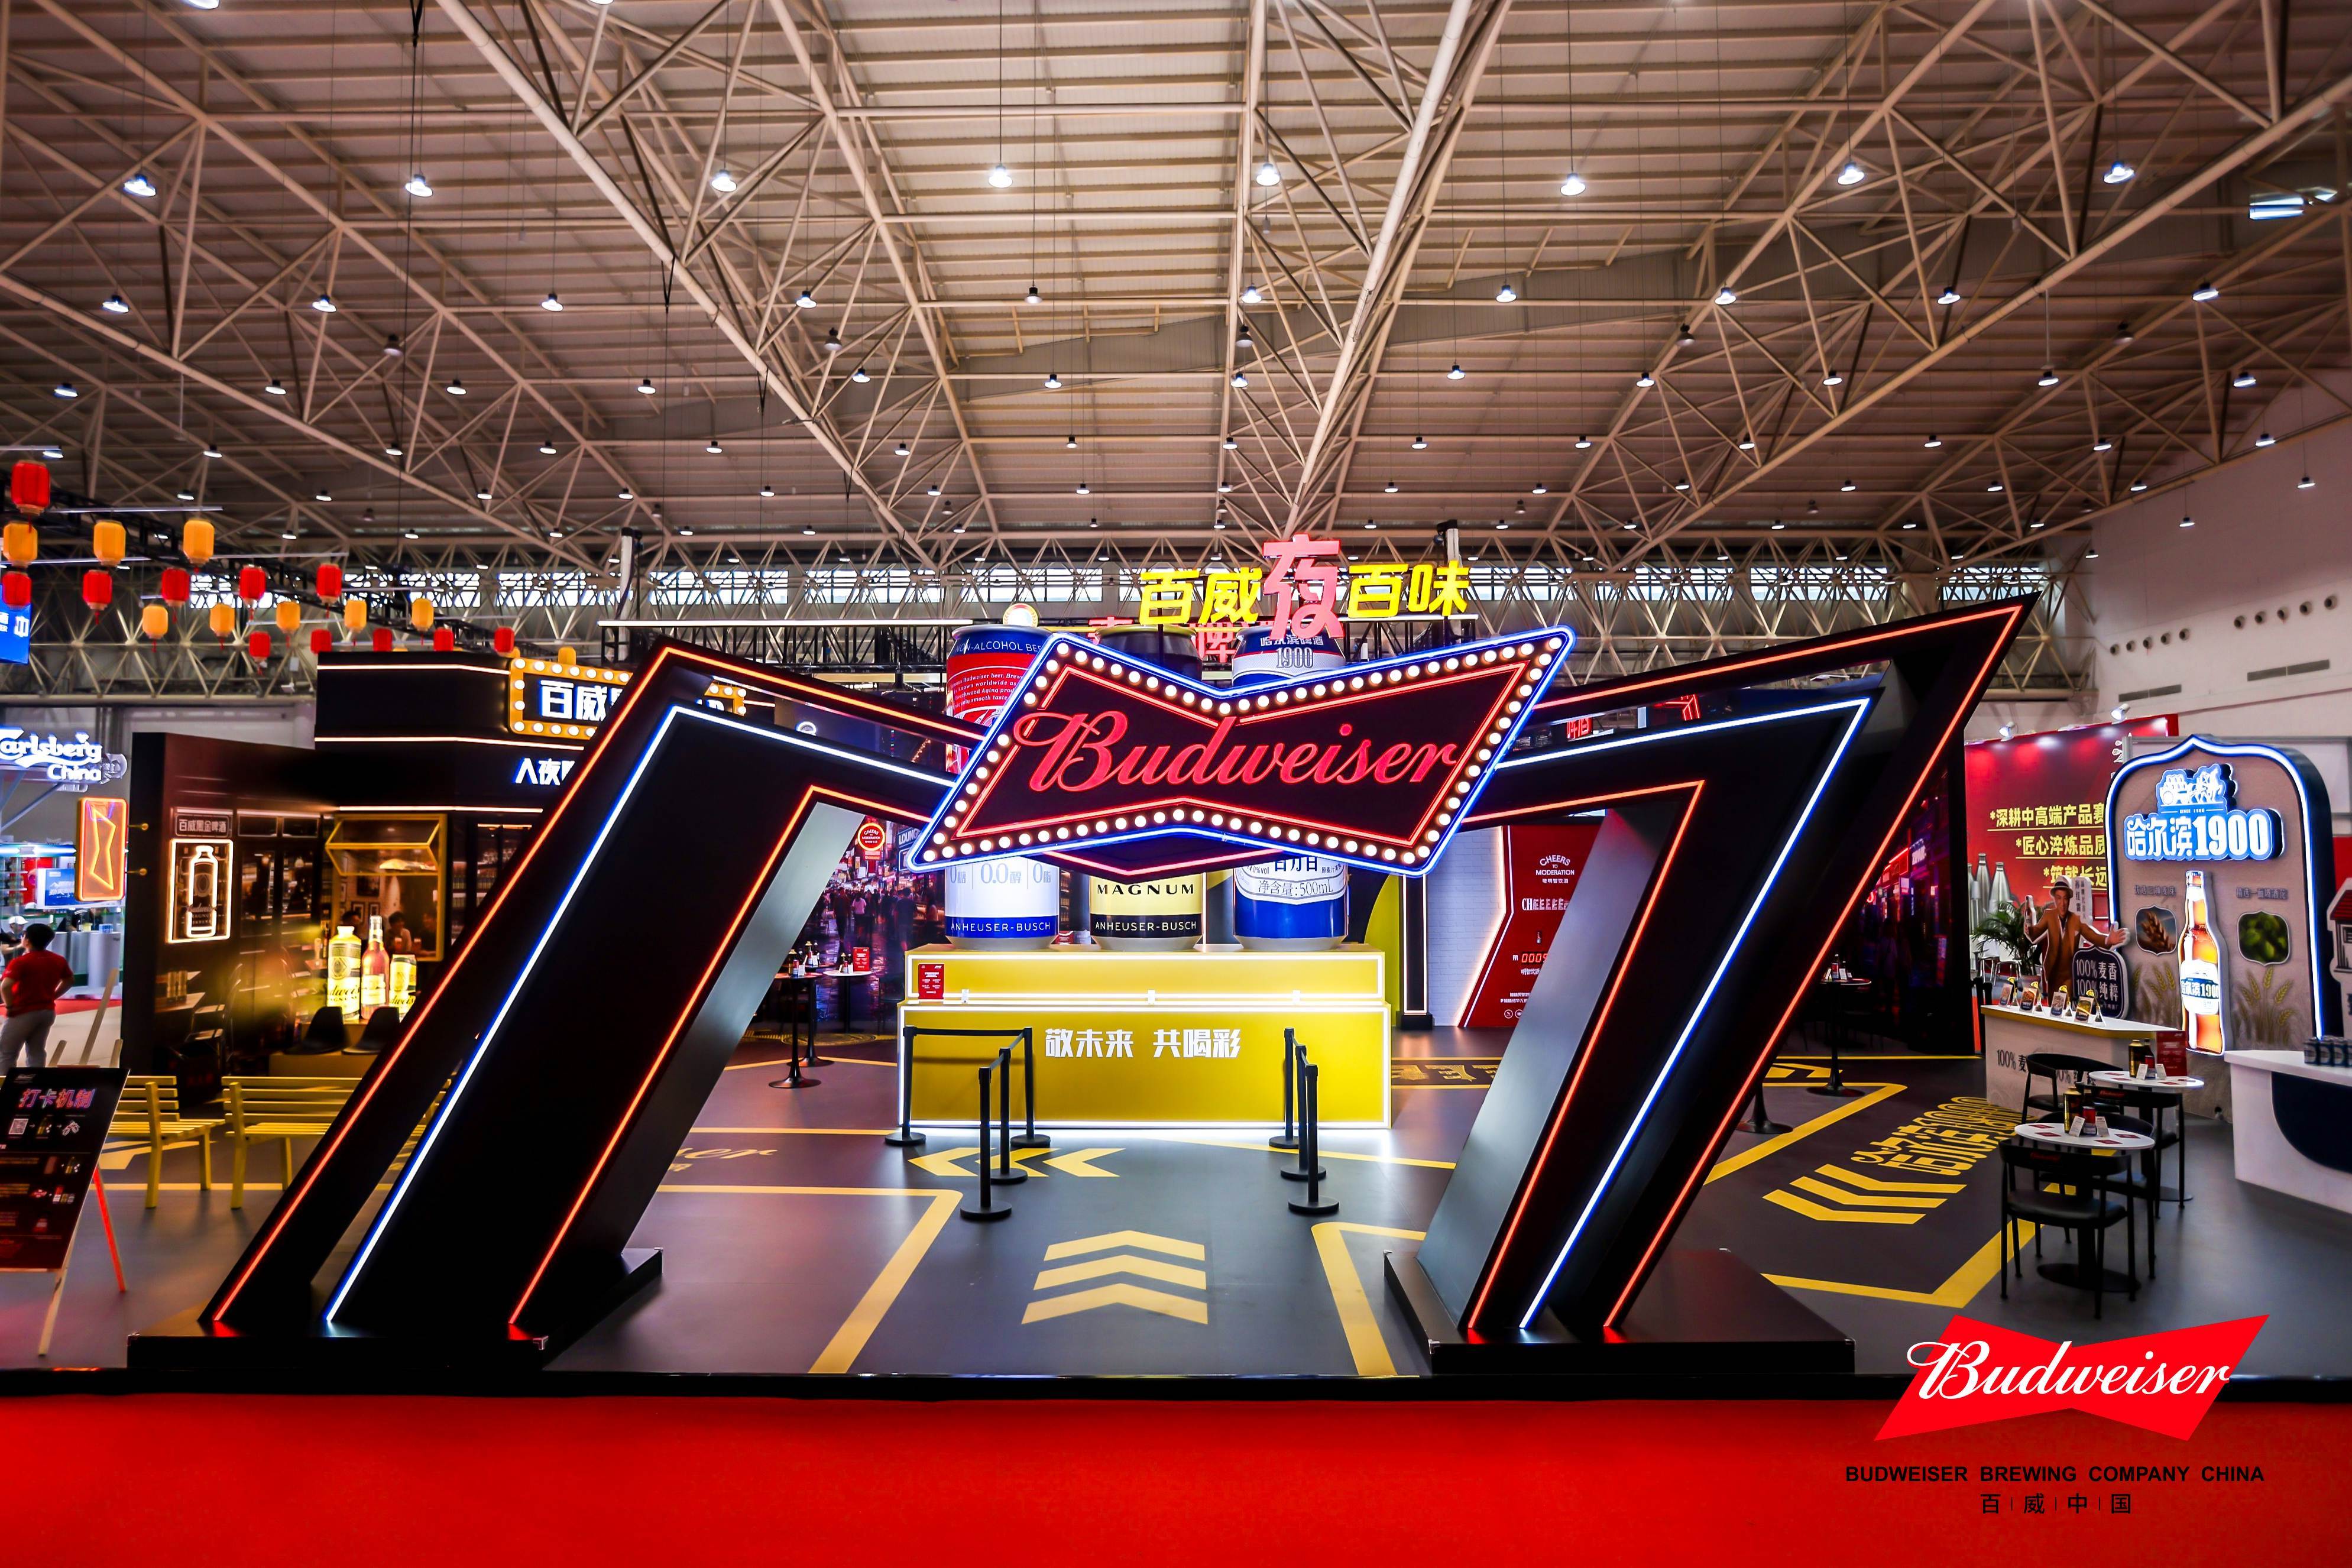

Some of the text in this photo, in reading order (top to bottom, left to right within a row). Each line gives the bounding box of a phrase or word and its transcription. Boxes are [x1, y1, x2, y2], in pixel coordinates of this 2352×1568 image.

[1026, 643, 1042, 652] BEE
[1277, 647, 1314, 668] 1900
[963, 674, 989, 682] Budweiser
[1013, 710, 1457, 792] Budweiser
[47, 764, 102, 781] China
[2127, 814, 2269, 857] 哈尔滨1900
[1540, 854, 1571, 866] CHEERS
[1097, 884, 1194, 895] MAGNUM
[951, 921, 1050, 932] ANHEUSER-BUSCH
[1095, 921, 1197, 931] ANHEUSER-BUSCH
[1045, 1028, 1240, 1058] 敬未来 共喝彩
[18, 1088, 97, 1109] 打卡机制
